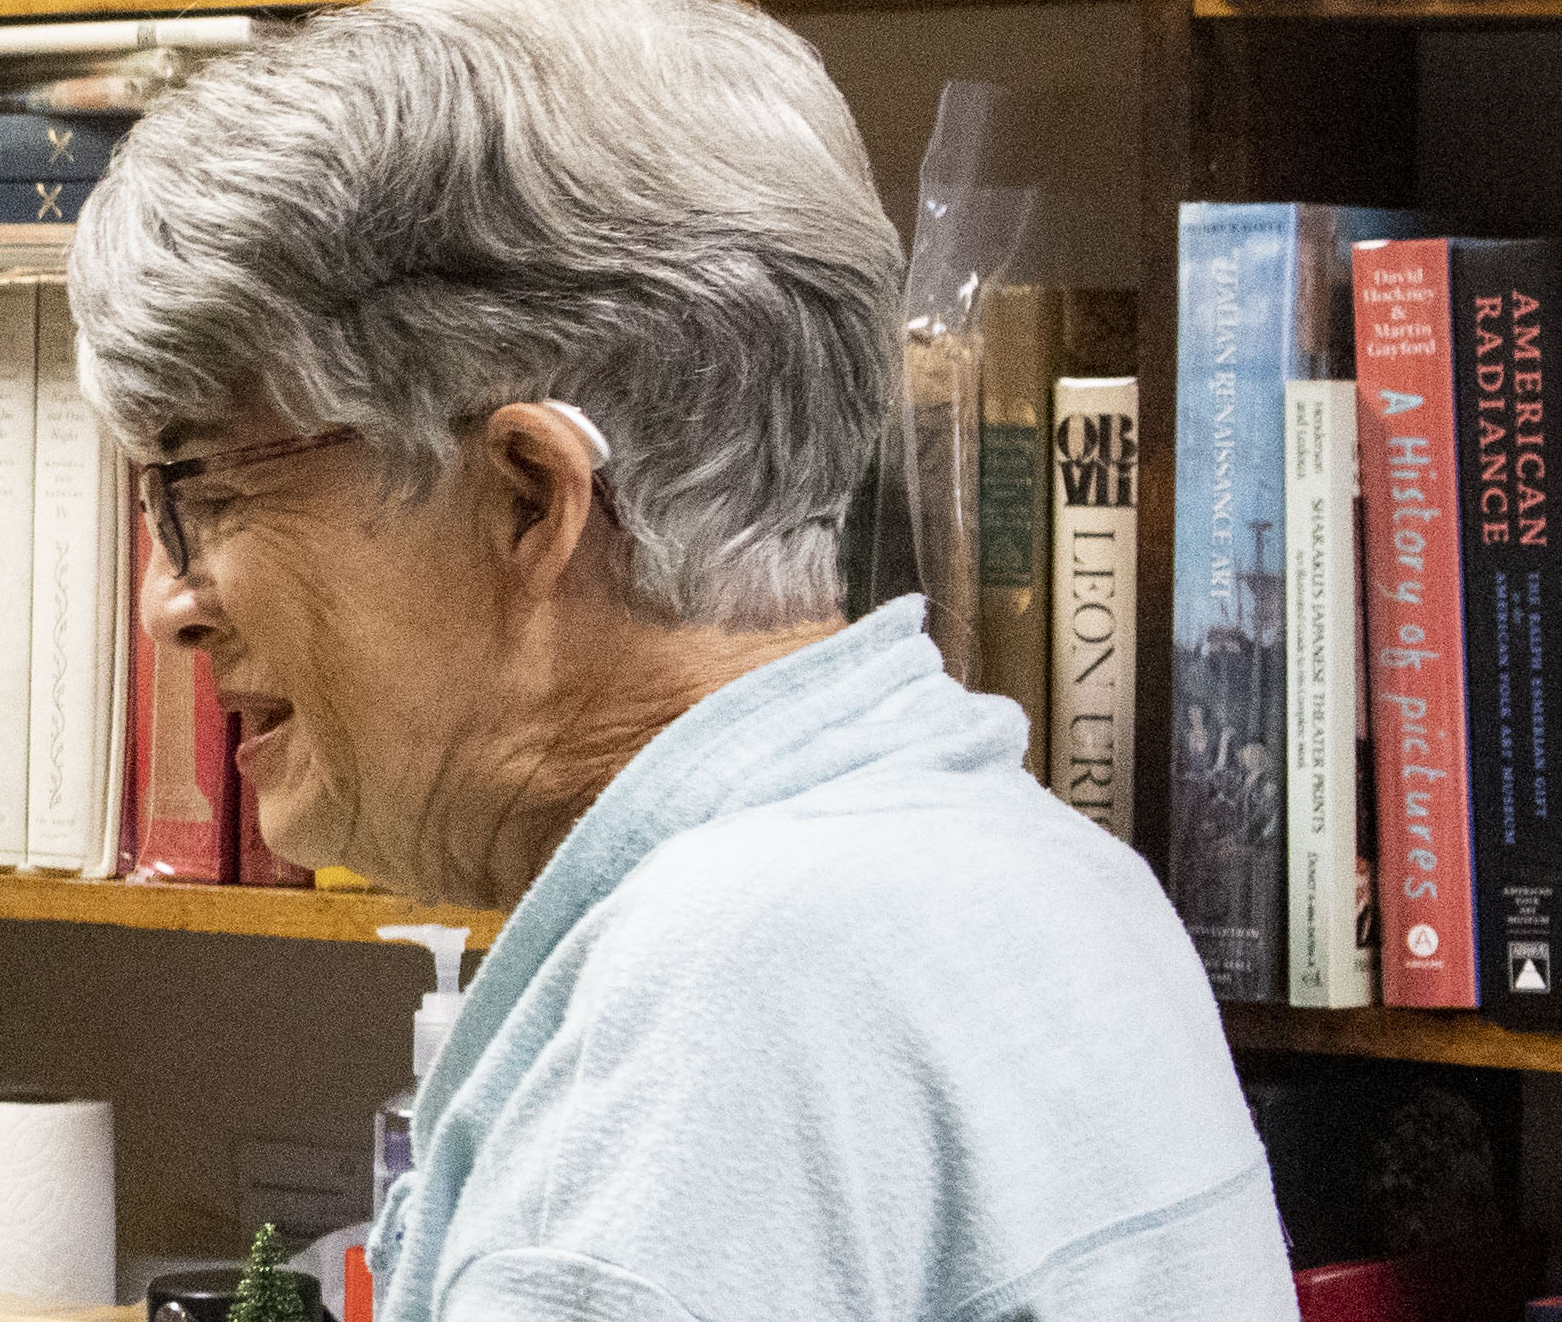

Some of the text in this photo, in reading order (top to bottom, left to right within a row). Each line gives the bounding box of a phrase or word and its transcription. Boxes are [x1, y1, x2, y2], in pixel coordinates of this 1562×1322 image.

[1362, 287, 1436, 307] Hockney
[1373, 267, 1424, 284] David
[1374, 323, 1433, 337] Martin
[1209, 371, 1235, 544] RENAISSANCE
[1473, 295, 1510, 546] RADIANCE
[1511, 289, 1547, 548] AMERICAN
[1209, 551, 1231, 599] ART
[1070, 530, 1116, 824] LEON URI
[1310, 604, 1325, 685] JAPANESE
[1377, 388, 1442, 902] A History of pictures
[1310, 693, 1325, 768] THEATER
[1310, 774, 1326, 833] PRINTS
